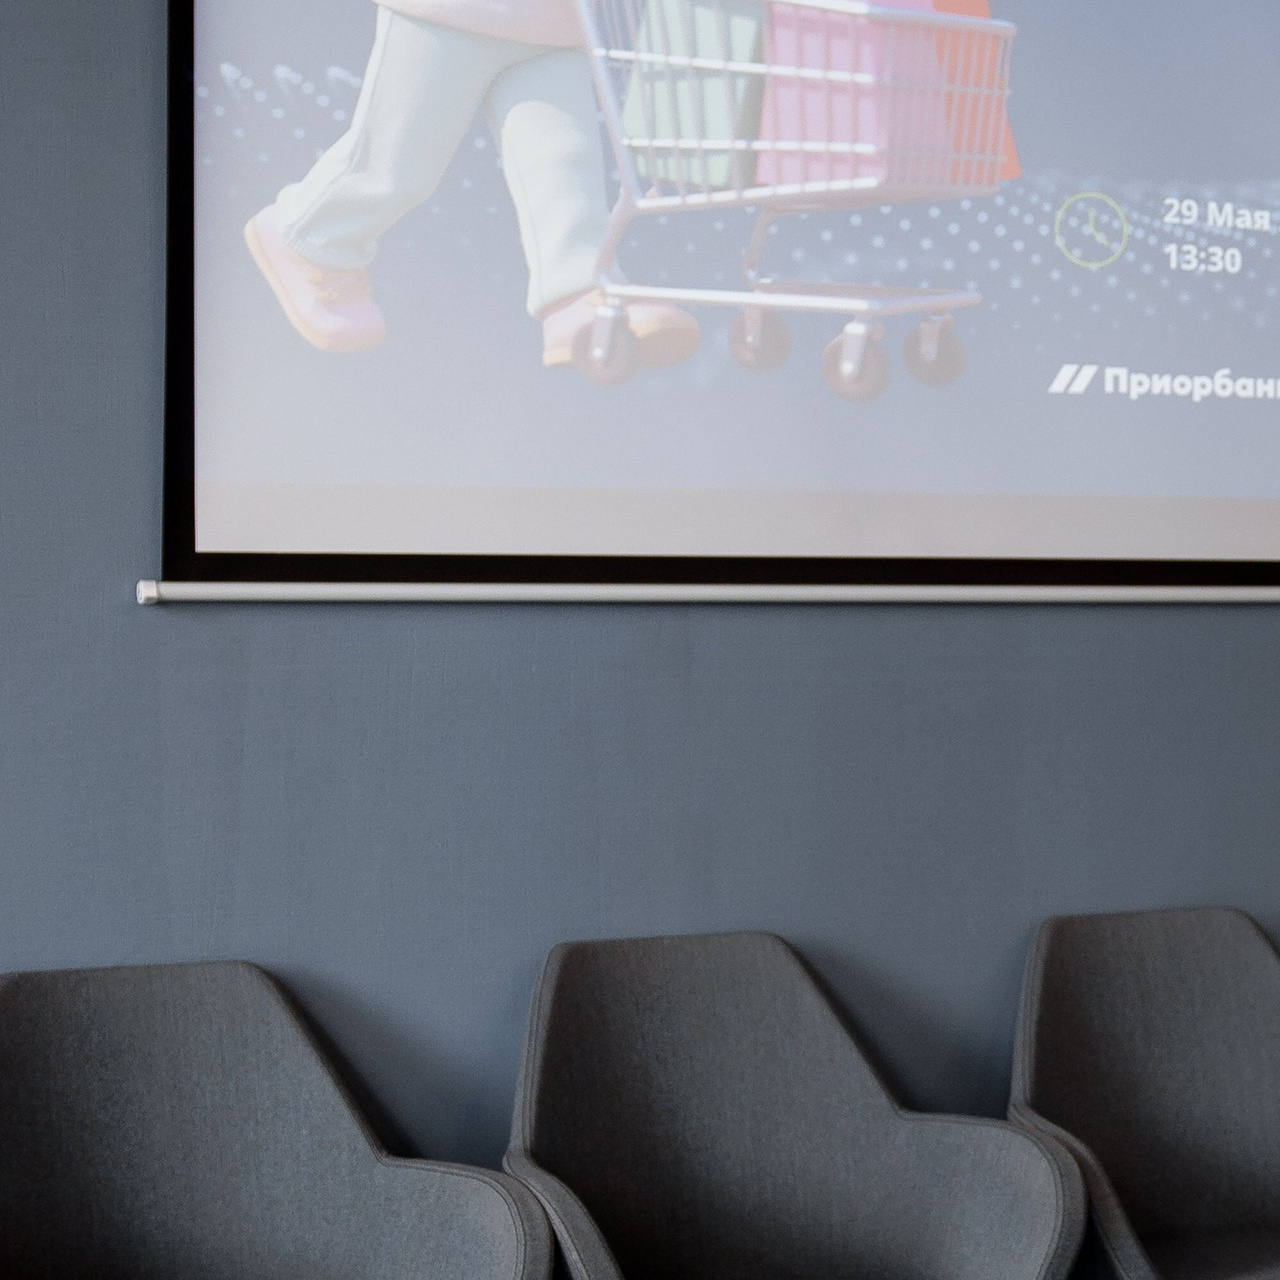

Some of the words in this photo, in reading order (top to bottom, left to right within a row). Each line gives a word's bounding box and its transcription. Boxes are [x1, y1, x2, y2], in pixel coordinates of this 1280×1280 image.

[1162, 197, 1198, 225] 29
[1206, 200, 1271, 231] Мая
[1163, 242, 1243, 274] 13:30
